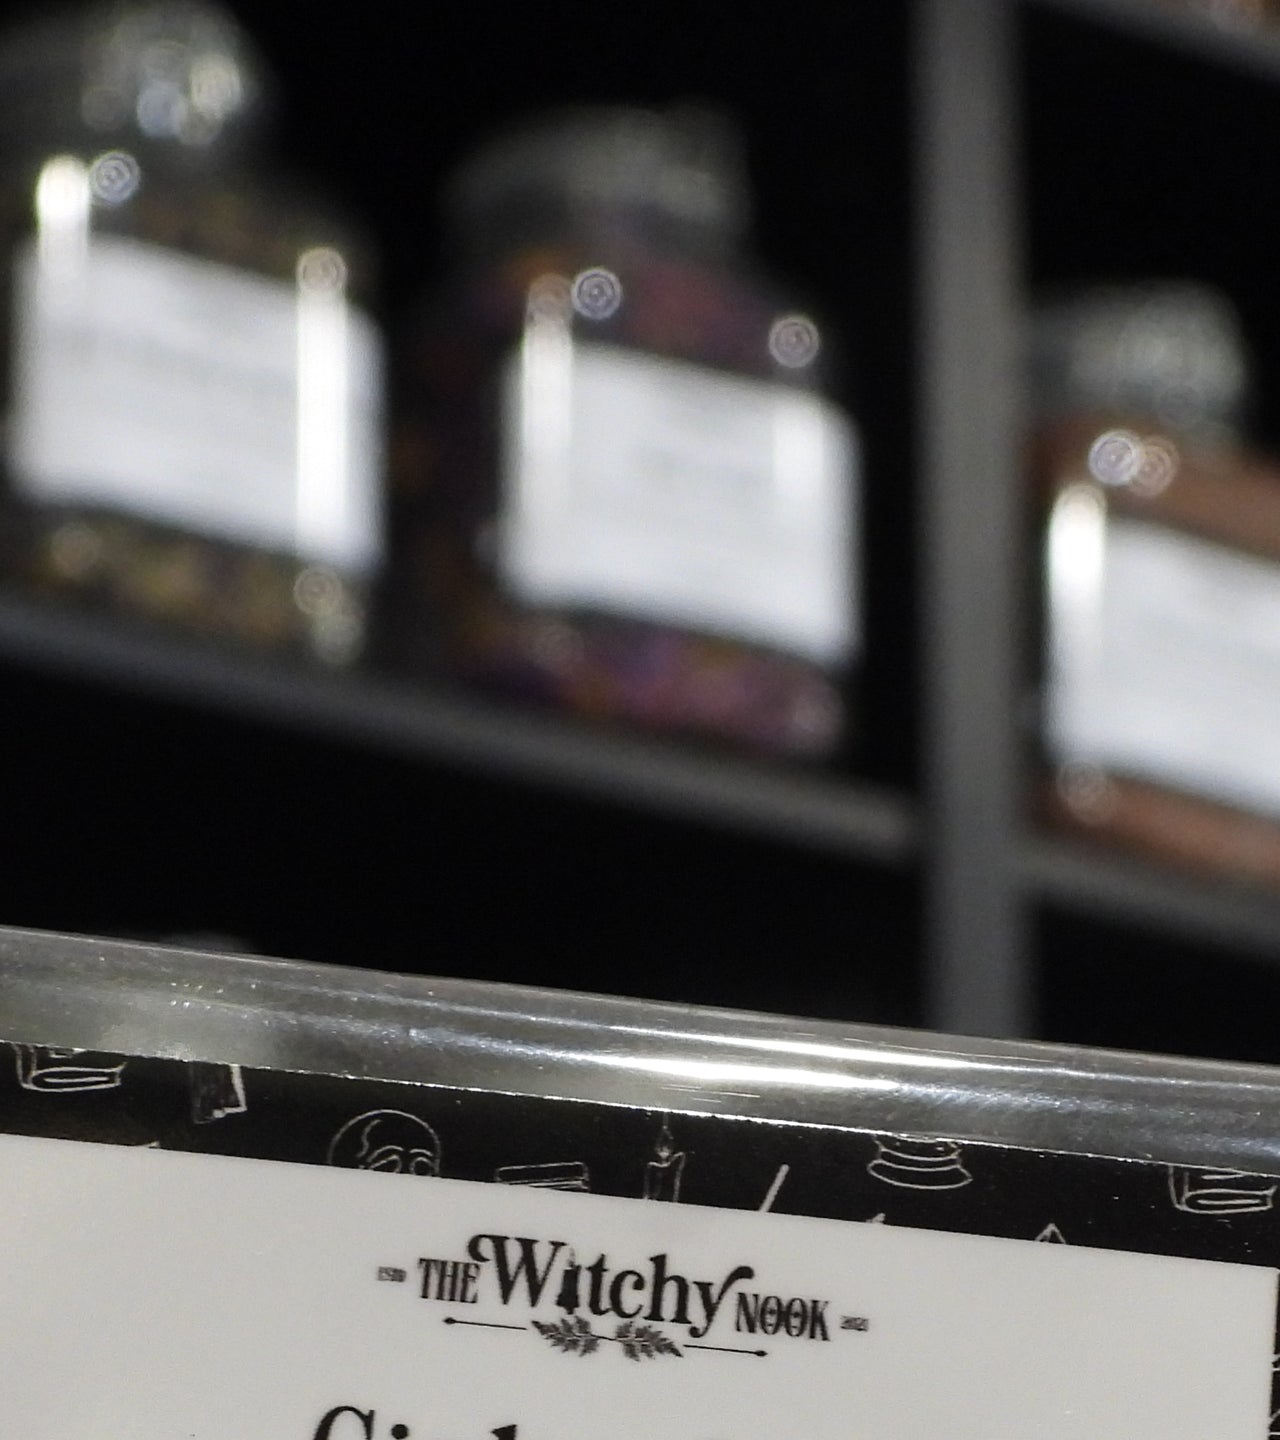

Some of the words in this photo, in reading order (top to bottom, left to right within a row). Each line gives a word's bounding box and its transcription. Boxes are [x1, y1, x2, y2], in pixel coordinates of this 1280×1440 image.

[418, 1257, 480, 1304] THE
[467, 1233, 755, 1338] Witchy
[734, 1291, 831, 1341] NOOK
